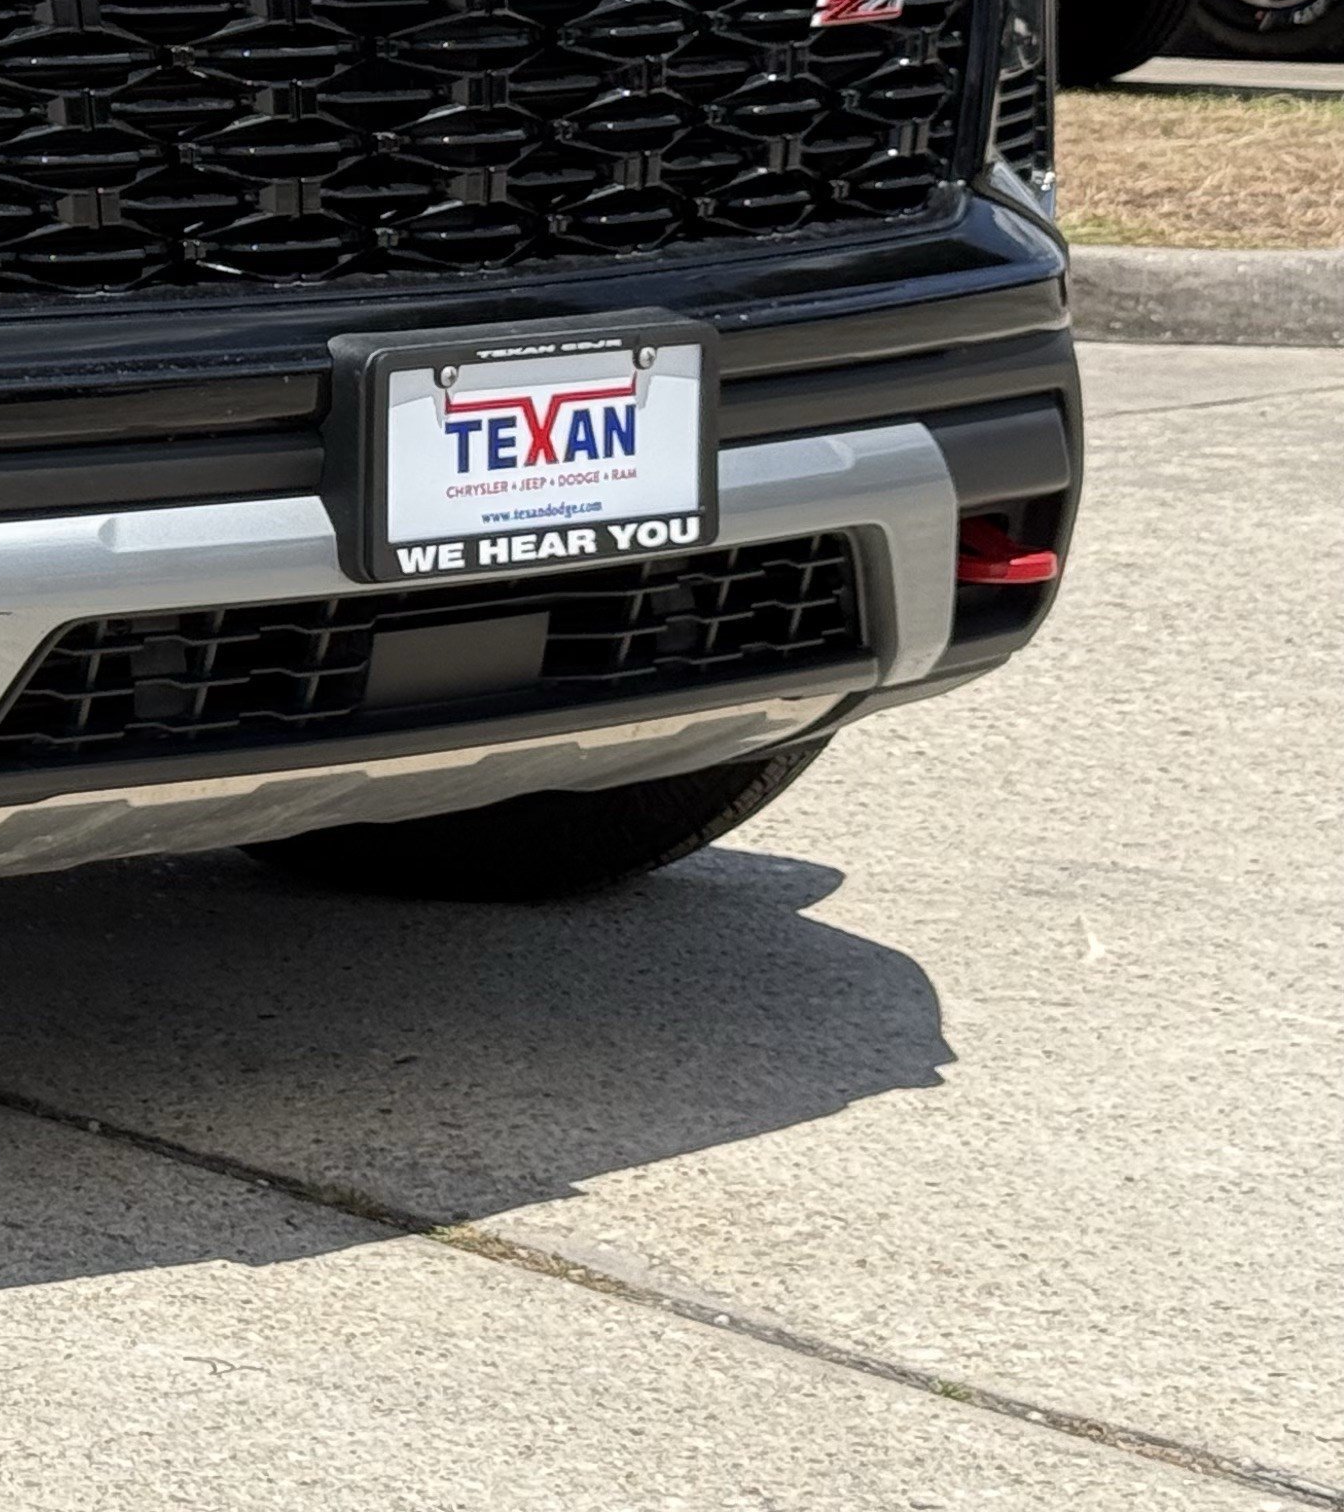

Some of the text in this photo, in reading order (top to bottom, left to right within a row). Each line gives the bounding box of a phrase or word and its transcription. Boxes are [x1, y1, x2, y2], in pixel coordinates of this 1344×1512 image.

[476, 344, 556, 359] TEXAN
[445, 374, 637, 473] TEXAN
[446, 468, 637, 500] CHRYSLER JEEP DODGE RAM
[481, 501, 604, 525] www.texandodge.com
[397, 516, 701, 575] WE HEAR YOU
